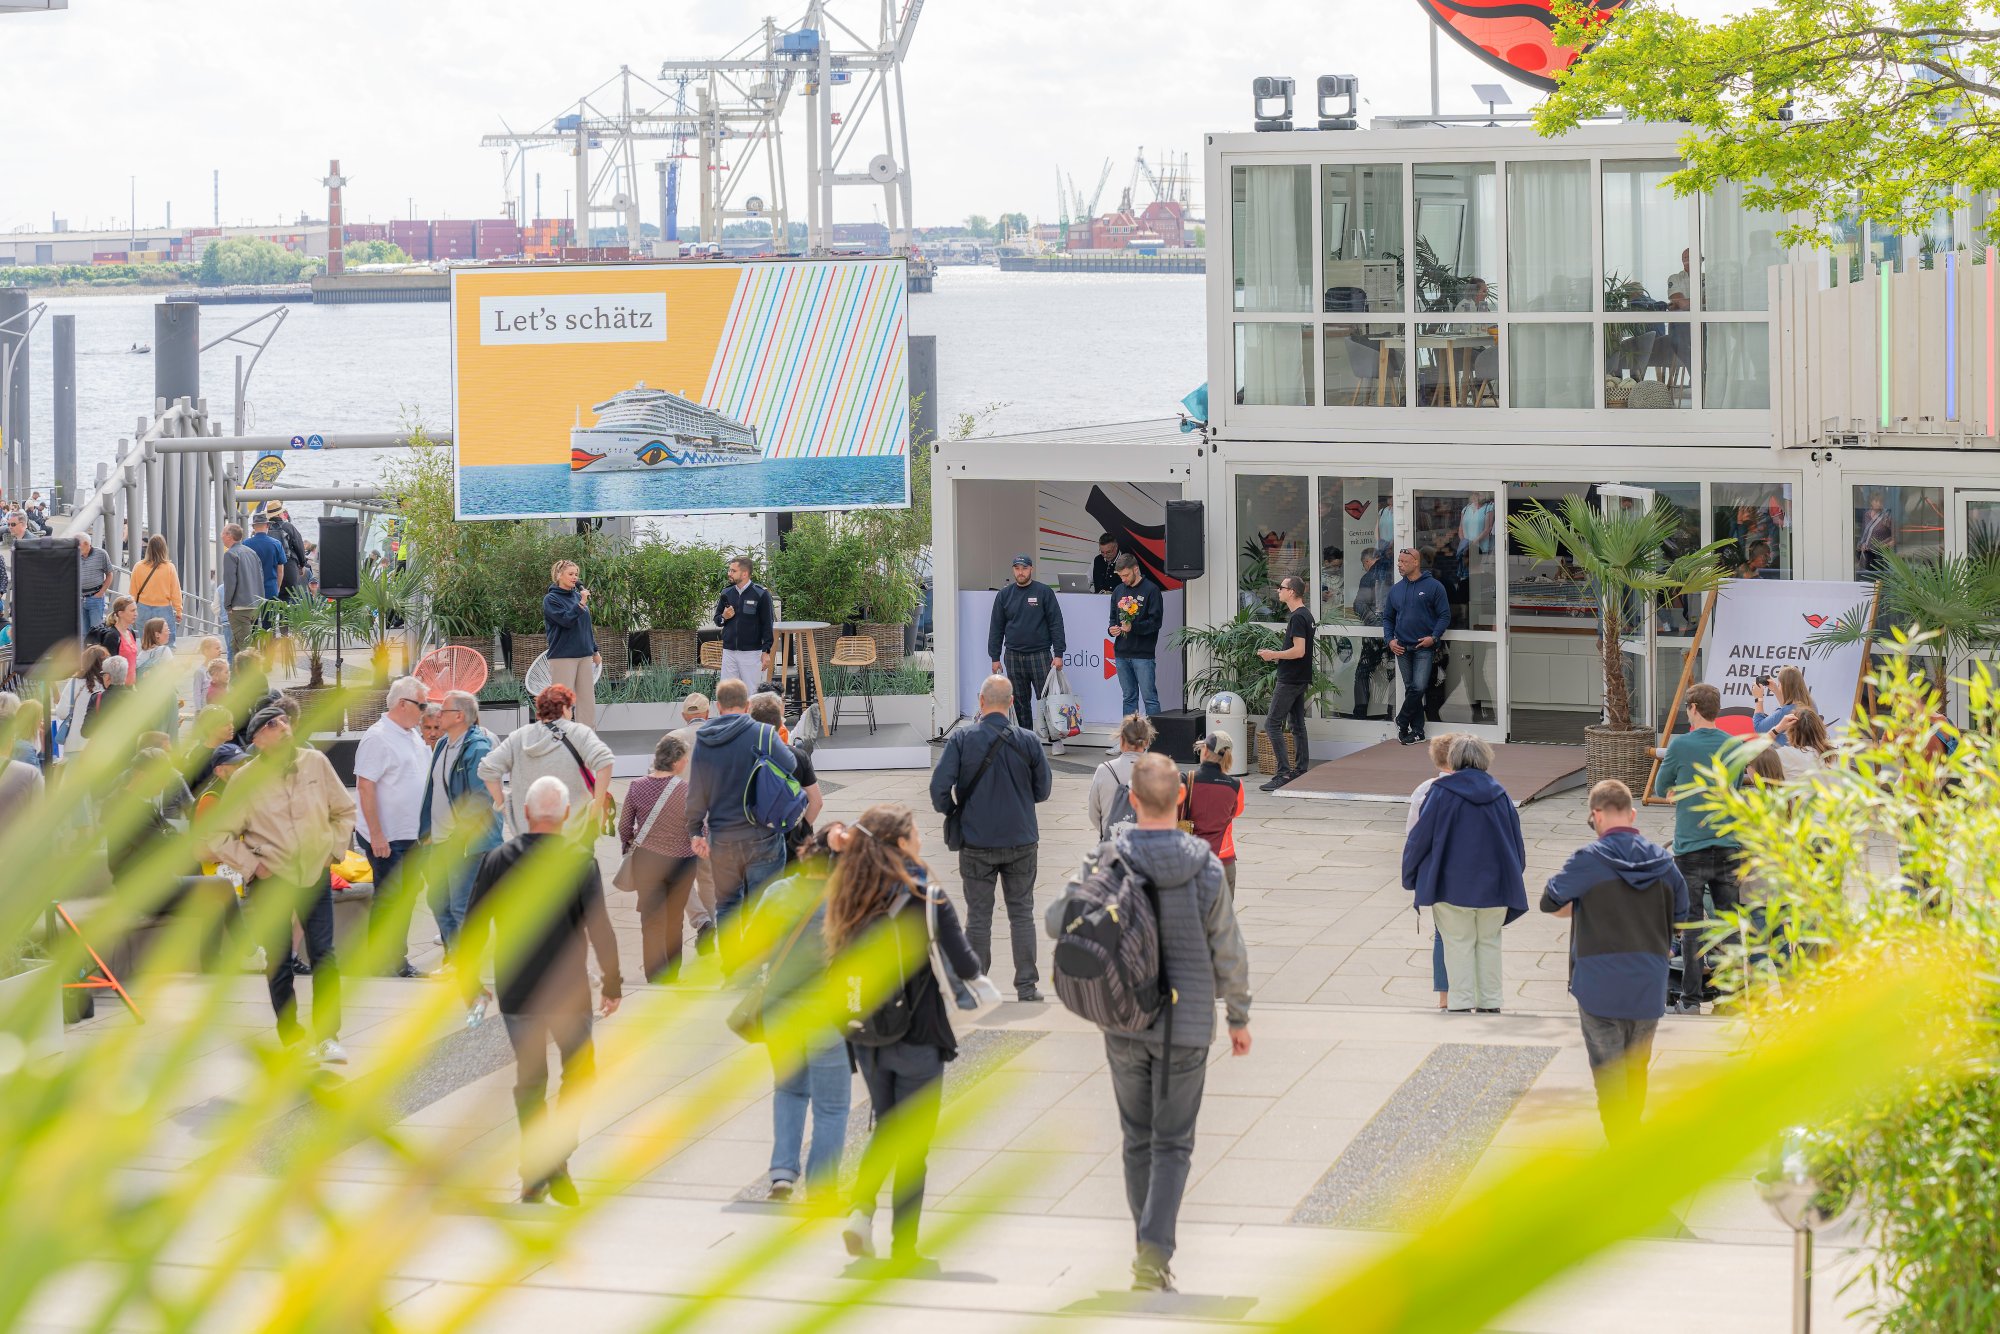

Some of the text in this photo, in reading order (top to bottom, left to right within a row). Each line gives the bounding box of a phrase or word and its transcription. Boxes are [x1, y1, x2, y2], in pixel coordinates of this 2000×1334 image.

[565, 306, 653, 330] schätz
[1063, 649, 1100, 668] adio
[1728, 644, 1812, 660] ANLEGEN
[1725, 663, 1806, 679] ABLEG
